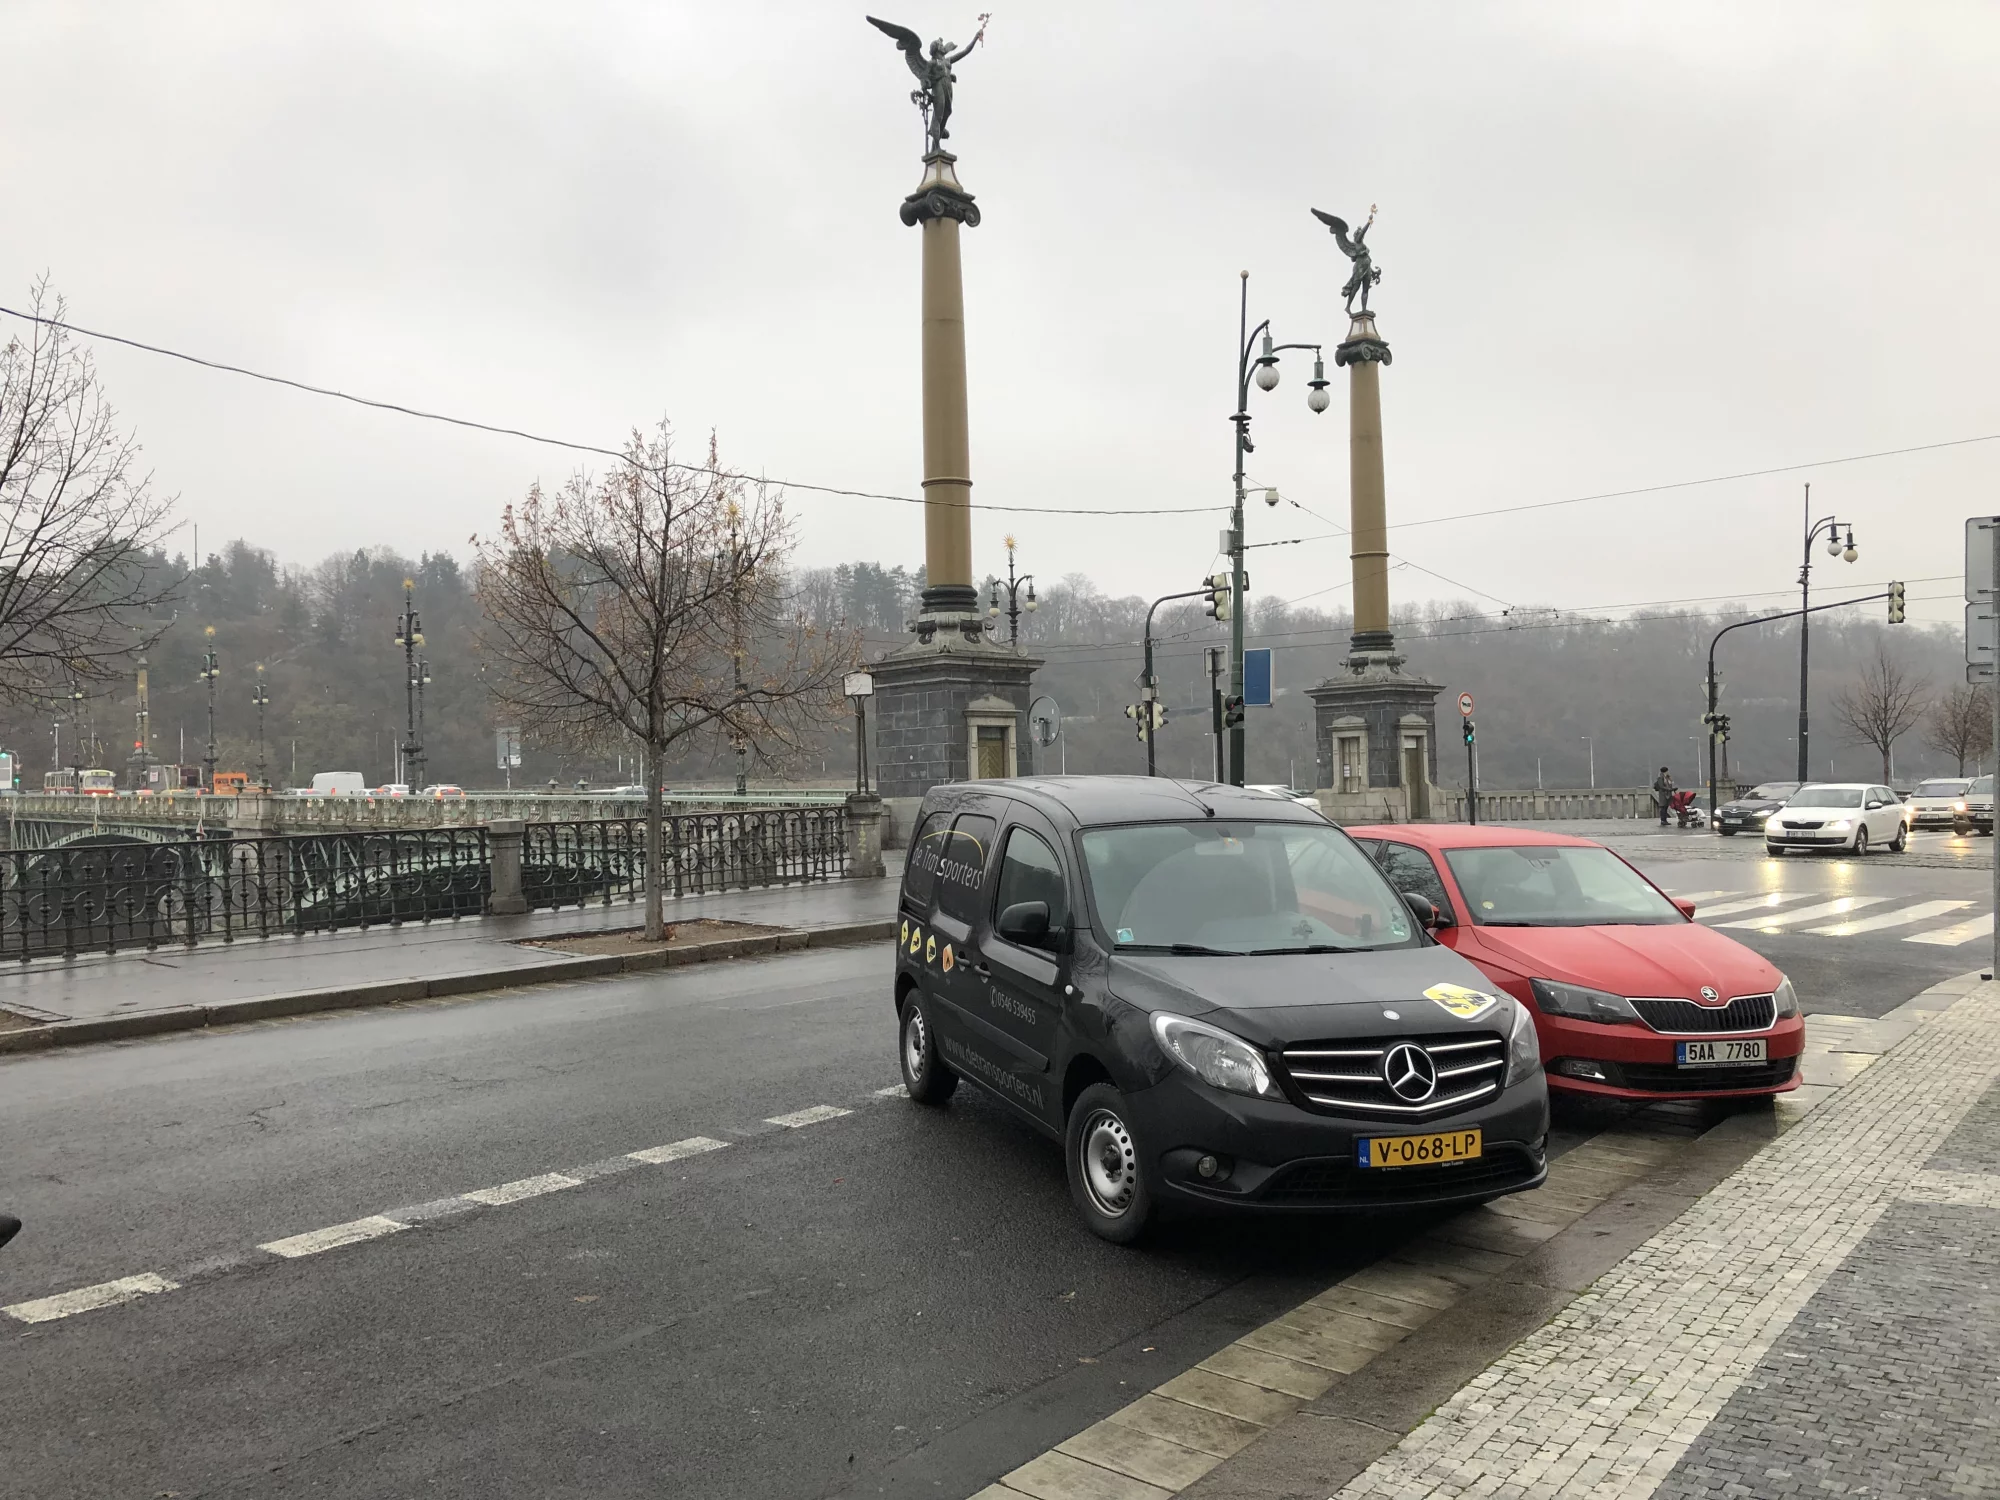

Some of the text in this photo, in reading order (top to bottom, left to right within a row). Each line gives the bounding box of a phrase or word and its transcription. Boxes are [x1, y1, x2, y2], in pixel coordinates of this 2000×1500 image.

[912, 841, 983, 890] de Transporters
[1689, 1042, 1760, 1061] 5AA 7780
[1359, 1156, 1369, 1164] NL
[1377, 1133, 1476, 1163] V-068-LP
